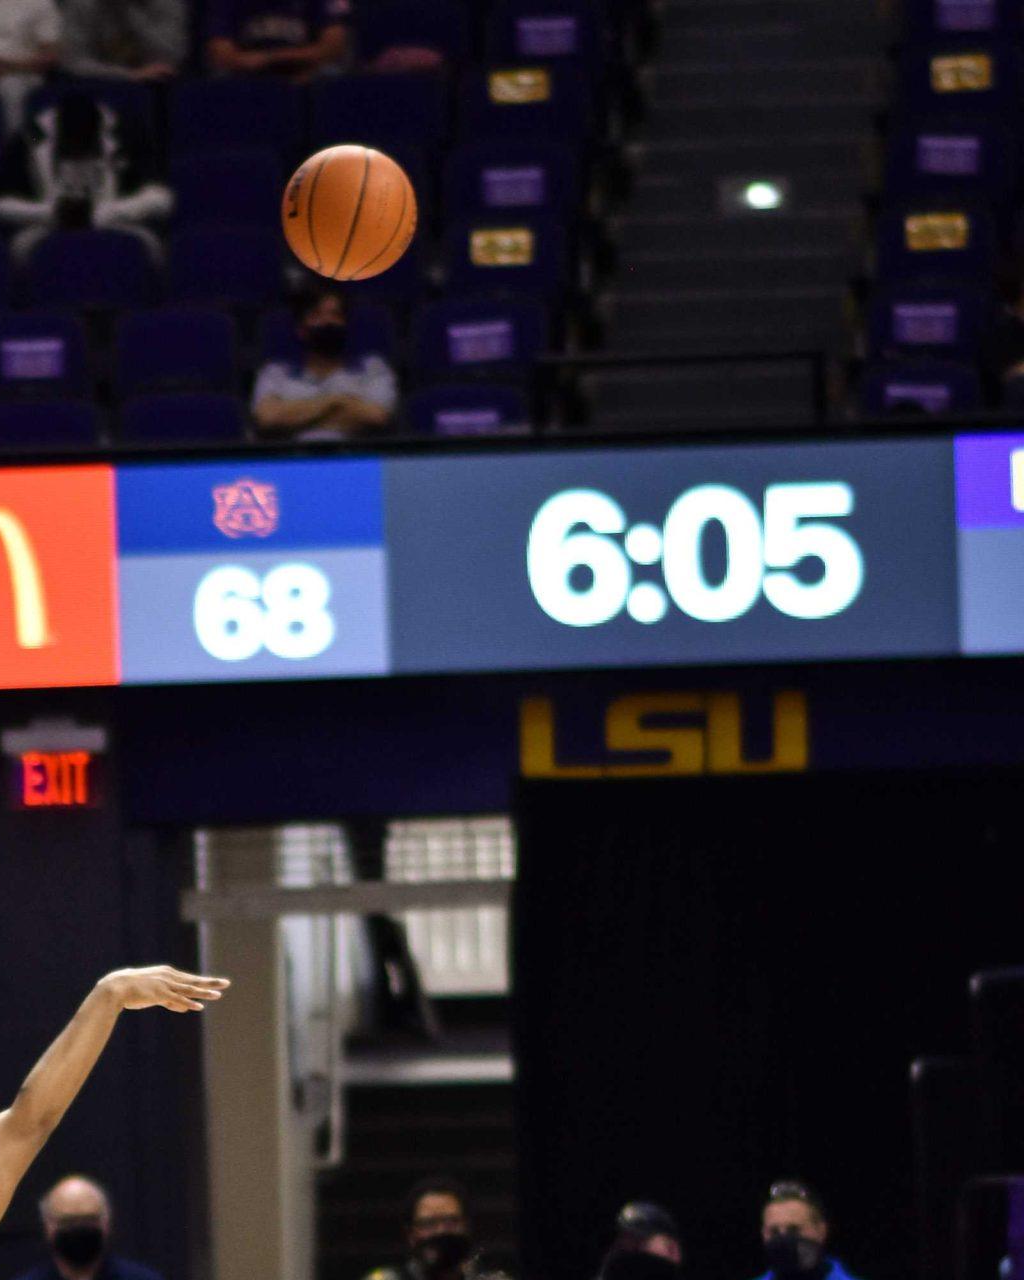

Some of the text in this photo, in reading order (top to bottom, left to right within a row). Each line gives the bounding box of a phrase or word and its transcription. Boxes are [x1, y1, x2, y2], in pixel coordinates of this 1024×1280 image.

[527, 482, 864, 628] 6:05
[193, 562, 336, 661] 68
[21, 750, 89, 806] EXIT
[520, 690, 809, 778] LSU
